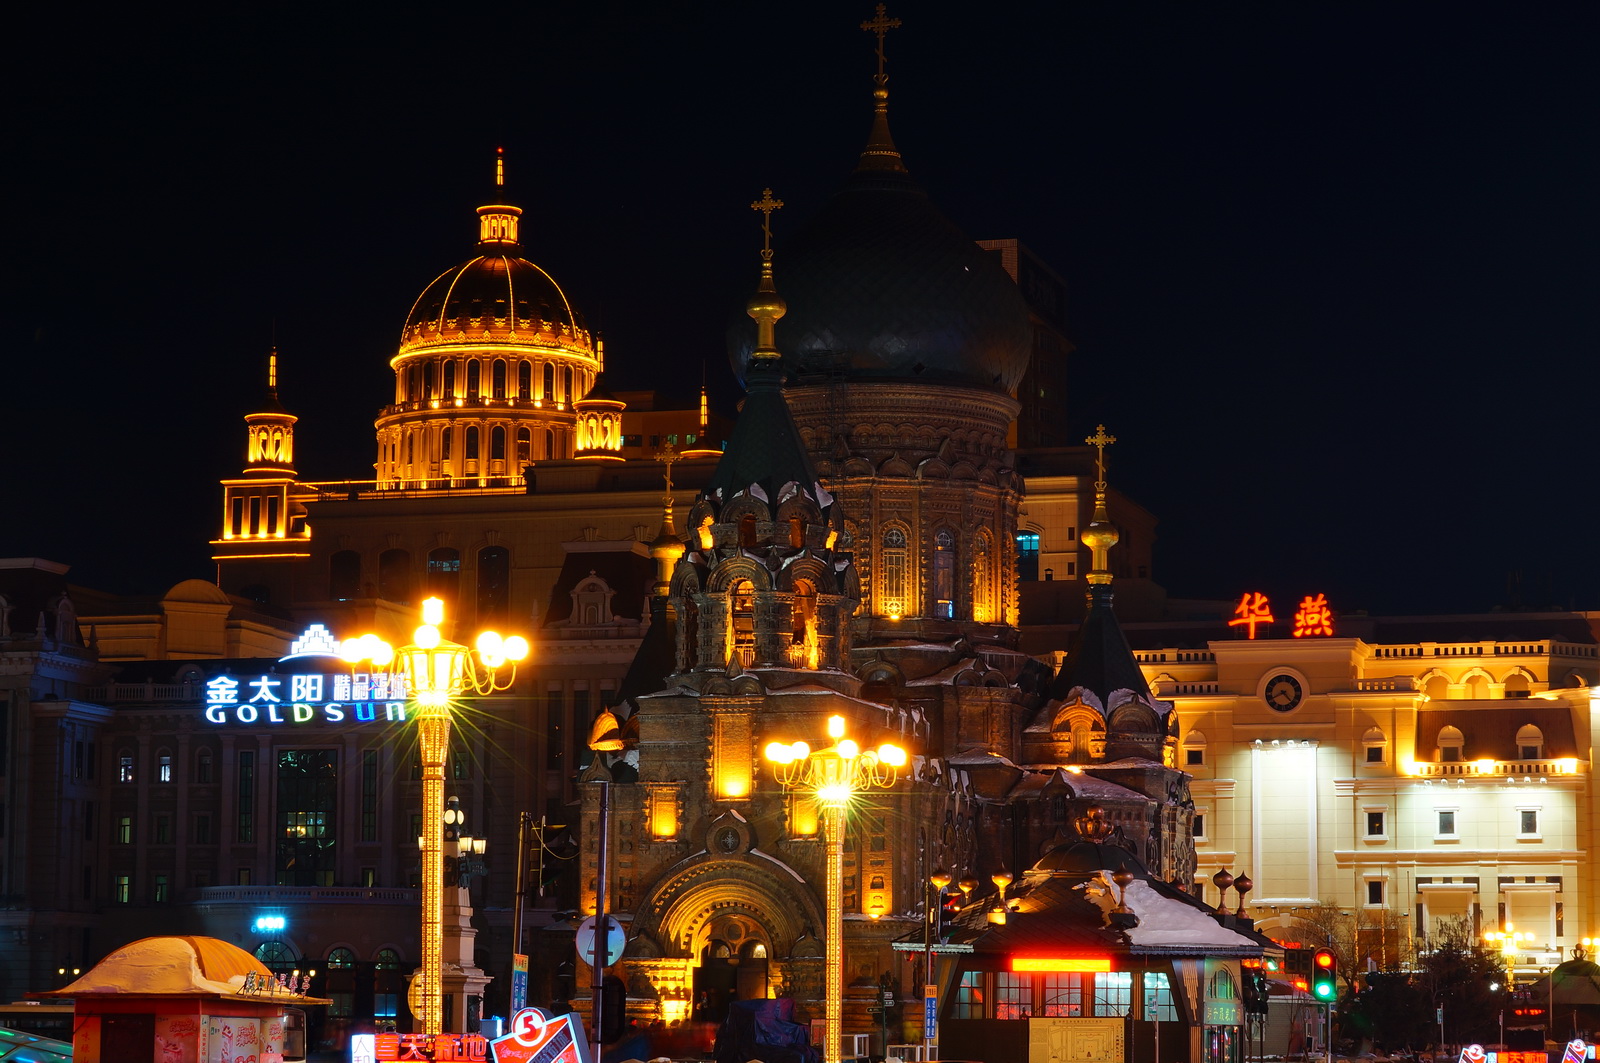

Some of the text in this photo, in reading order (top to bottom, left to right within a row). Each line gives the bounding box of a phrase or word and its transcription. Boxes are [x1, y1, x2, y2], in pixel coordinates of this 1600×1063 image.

[1228, 592, 1333, 639] 华燕
[206, 675, 323, 703] 金太阳
[523, 1015, 537, 1040] 5
